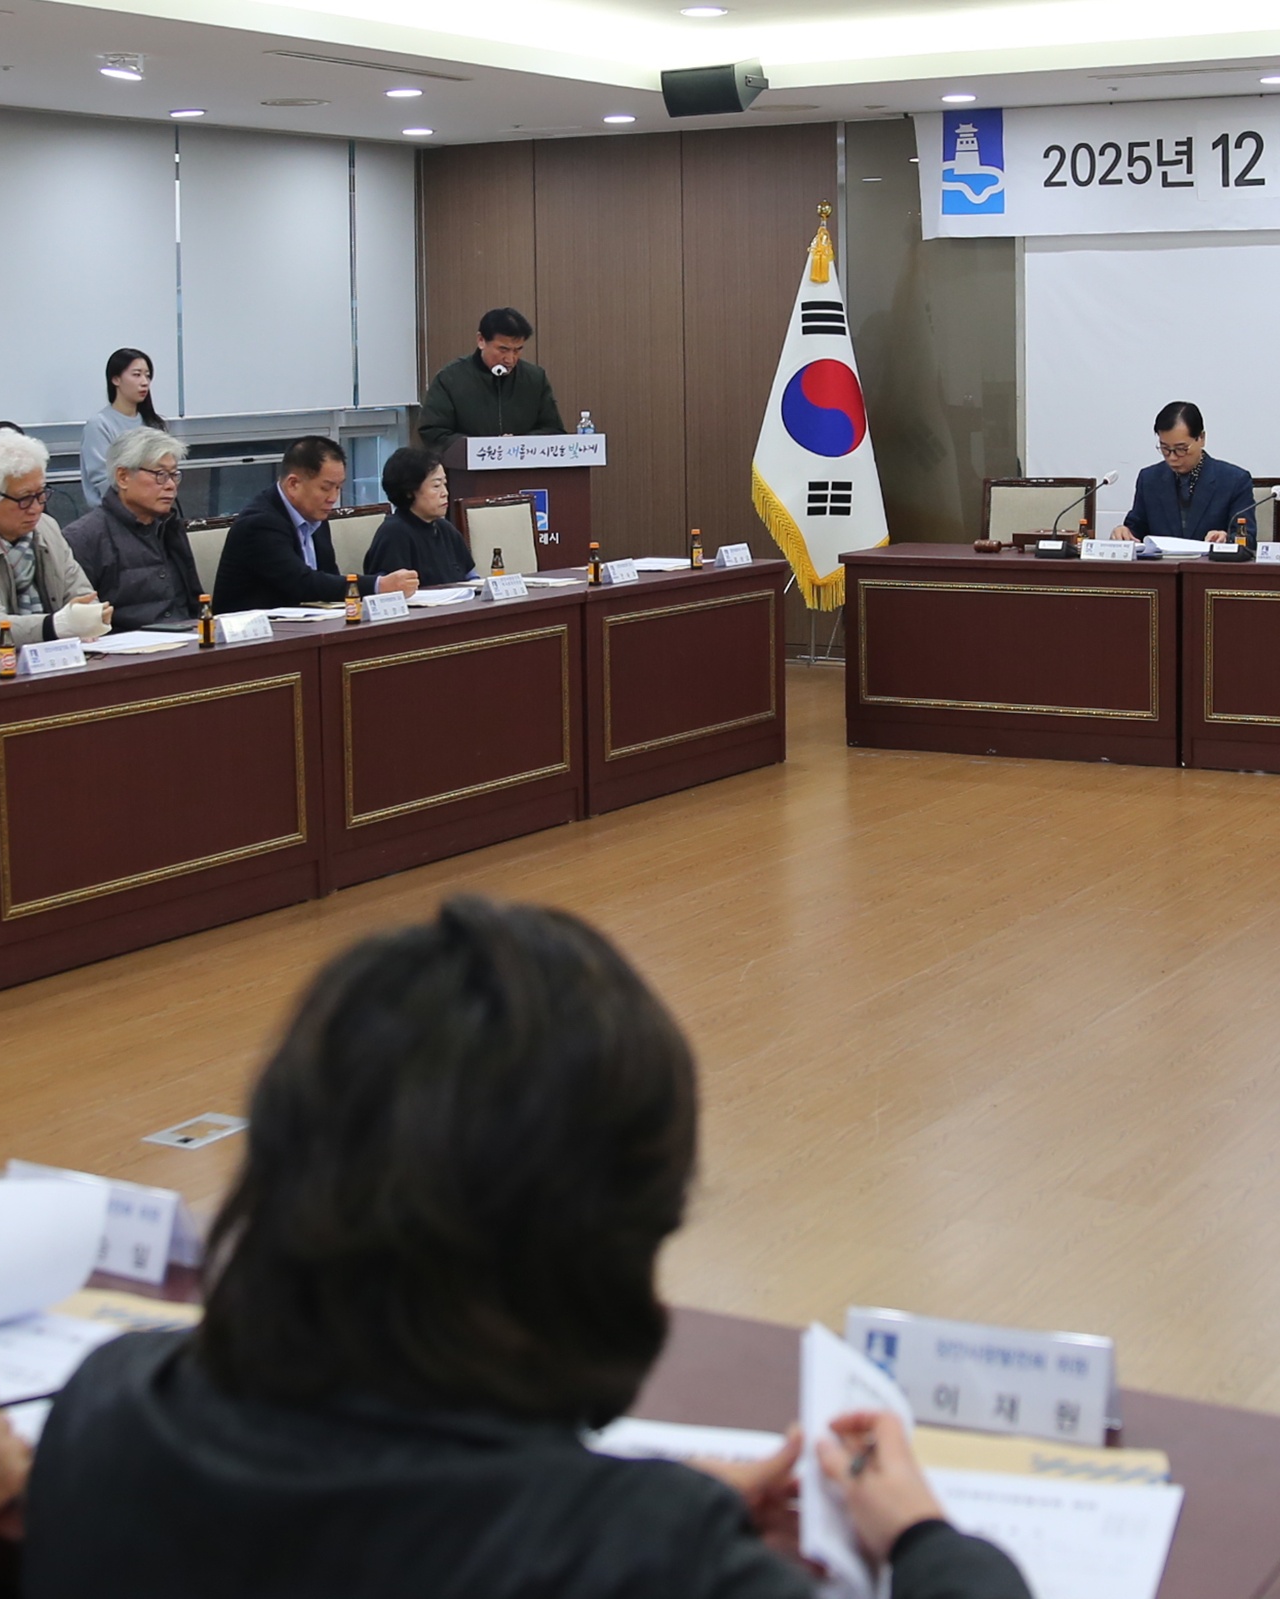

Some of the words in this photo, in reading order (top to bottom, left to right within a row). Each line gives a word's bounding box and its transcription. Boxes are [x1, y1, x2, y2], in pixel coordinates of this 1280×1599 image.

[1042, 136, 1195, 188] 2025년
[1211, 130, 1266, 188] 12
[476, 445, 504, 461] 수원을
[506, 444, 537, 460] 새롭게
[539, 445, 566, 458] 시민을
[568, 442, 599, 460] 빛나게
